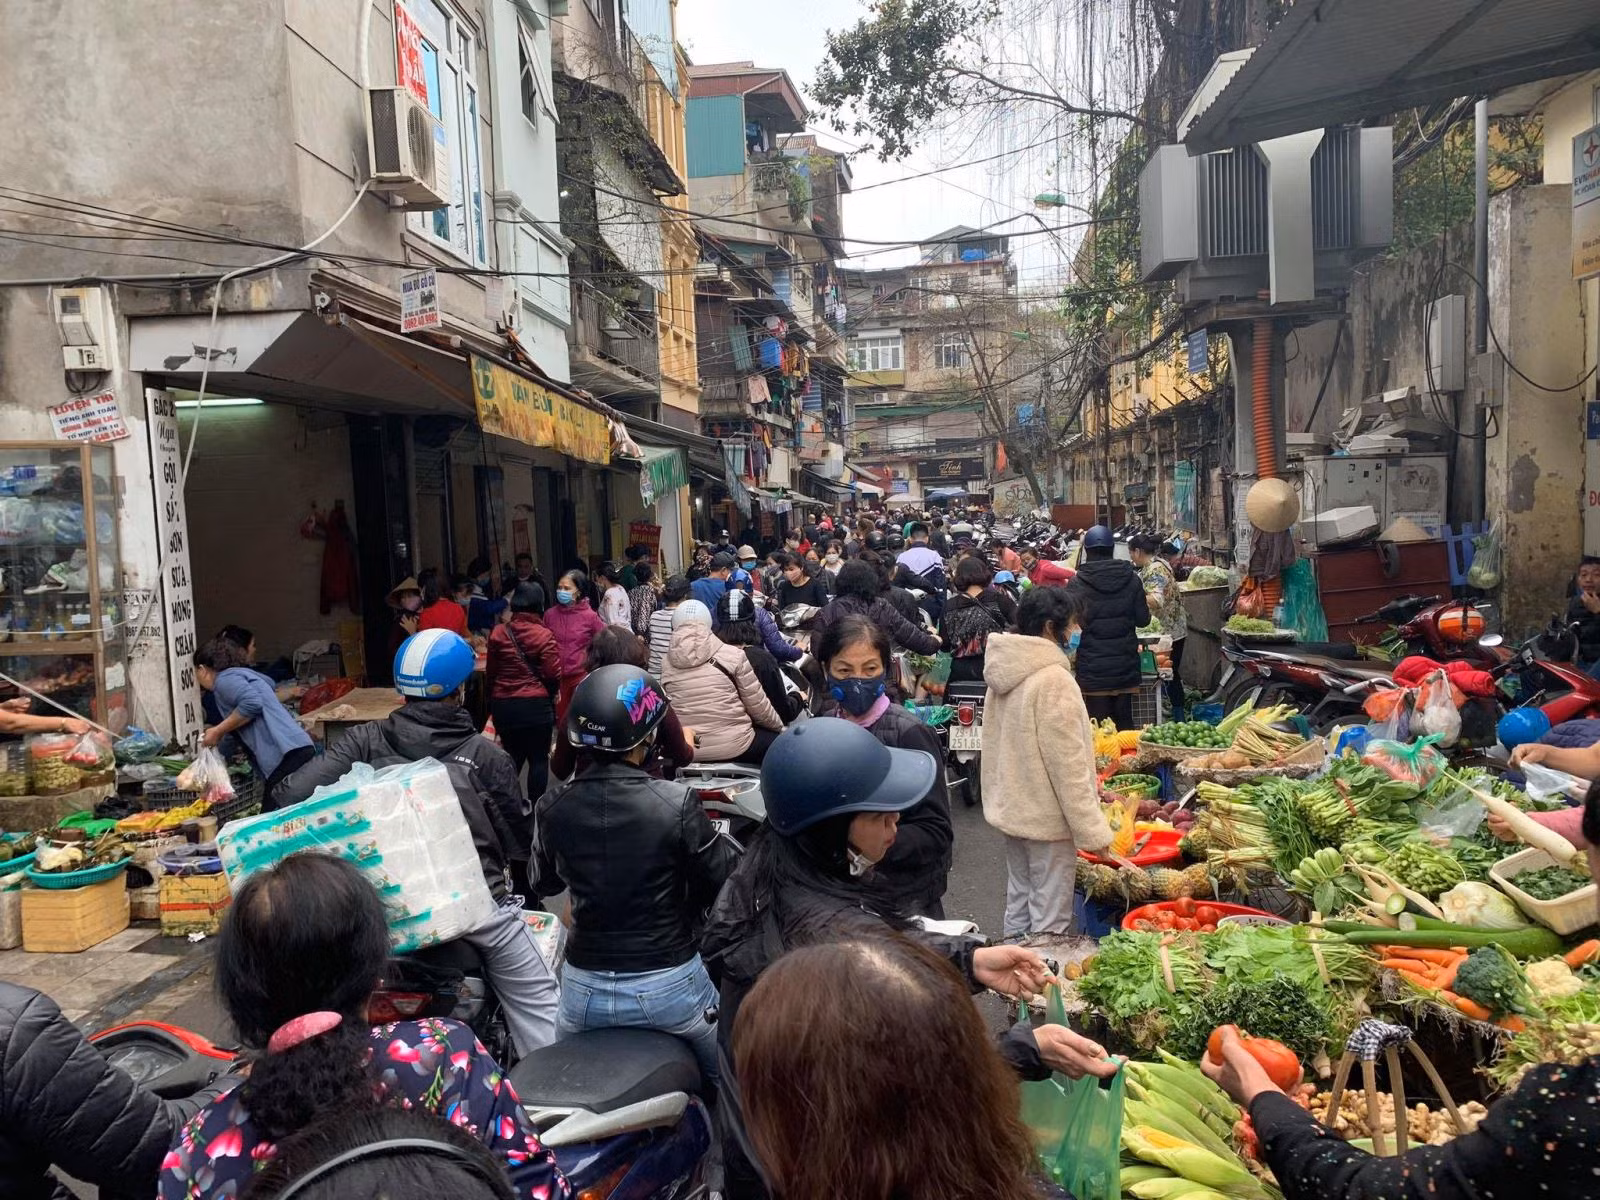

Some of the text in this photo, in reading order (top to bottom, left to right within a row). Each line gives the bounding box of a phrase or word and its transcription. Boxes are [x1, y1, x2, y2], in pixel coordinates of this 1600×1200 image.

[54, 393, 114, 416] LUYỆN THI
[169, 401, 175, 417] 2
[171, 597, 192, 624] MÓNG
[180, 663, 194, 691] SÓC
[185, 703, 196, 724] DA
